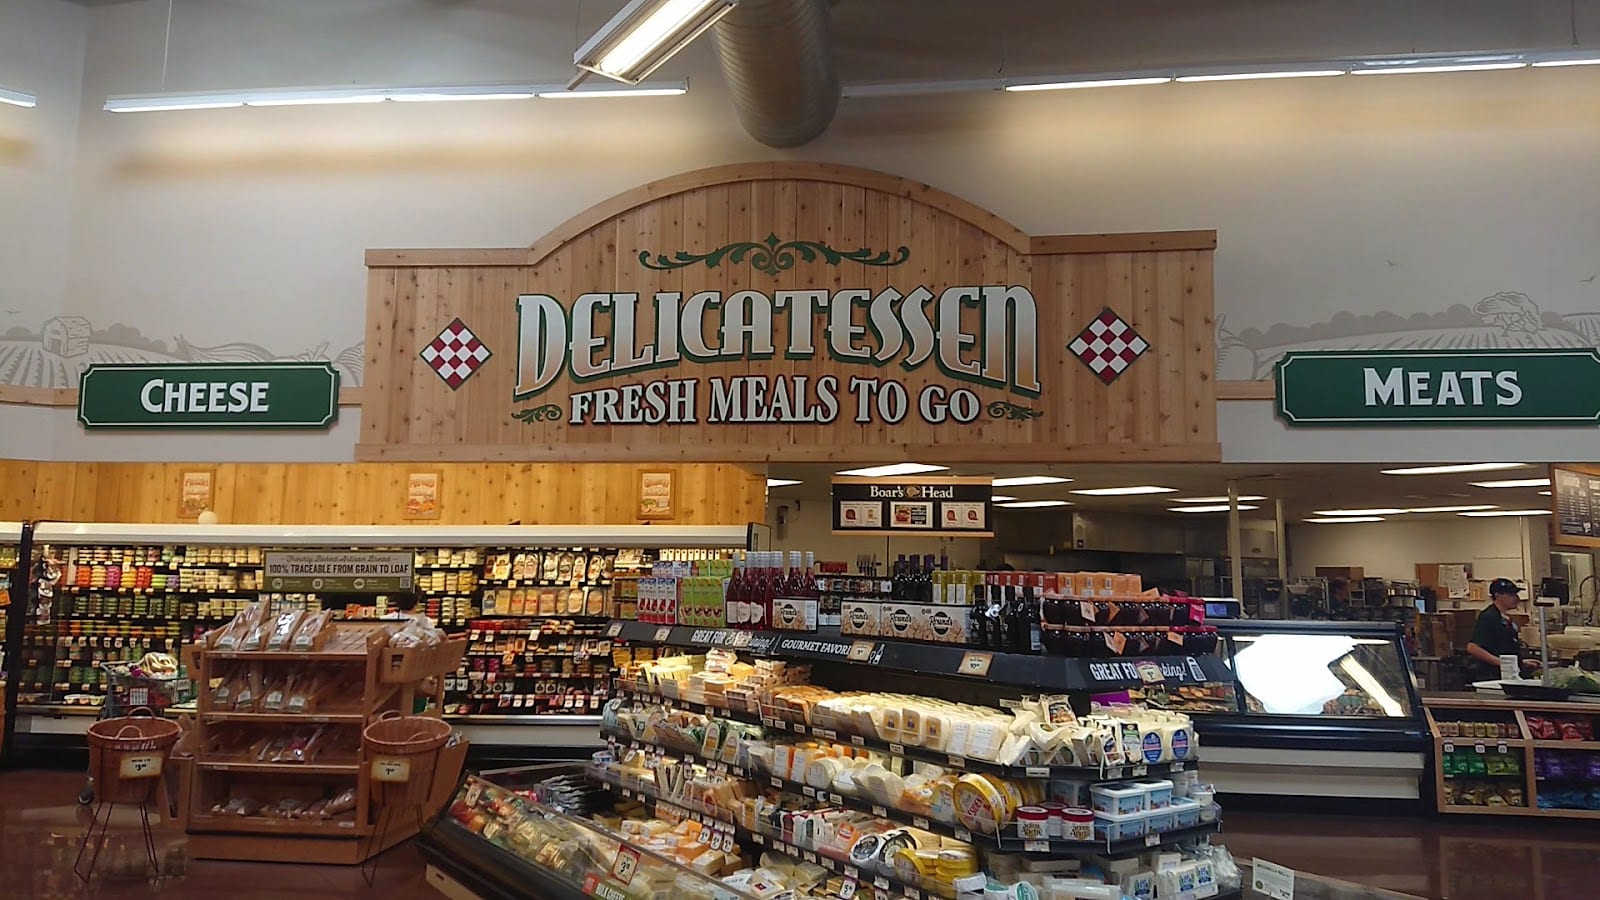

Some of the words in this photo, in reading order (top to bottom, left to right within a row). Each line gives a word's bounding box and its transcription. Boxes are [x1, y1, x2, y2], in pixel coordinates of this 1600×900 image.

[514, 284, 1042, 399] DELICATESSEN
[140, 378, 270, 413] CHEESE
[1362, 366, 1523, 406] MEATS
[568, 378, 702, 426] FRESH
[708, 374, 840, 426] MEALS
[850, 375, 908, 426] TO
[918, 385, 981, 425] GO
[870, 485, 904, 499] Boar's
[921, 485, 954, 499] Head
[269, 564, 289, 574] 100%
[290, 564, 331, 574] TRACEABLE
[333, 564, 354, 574] FROM
[355, 564, 378, 574] GRAIN
[380, 564, 389, 574] TO
[390, 564, 409, 574] LOAF
[691, 629, 714, 643] GREAT
[711, 631, 727, 645] FOR
[781, 639, 824, 653] GOURMET
[819, 641, 852, 657] FAVORI
[1089, 662, 1123, 681] GREAT
[1122, 662, 1140, 680] FO
